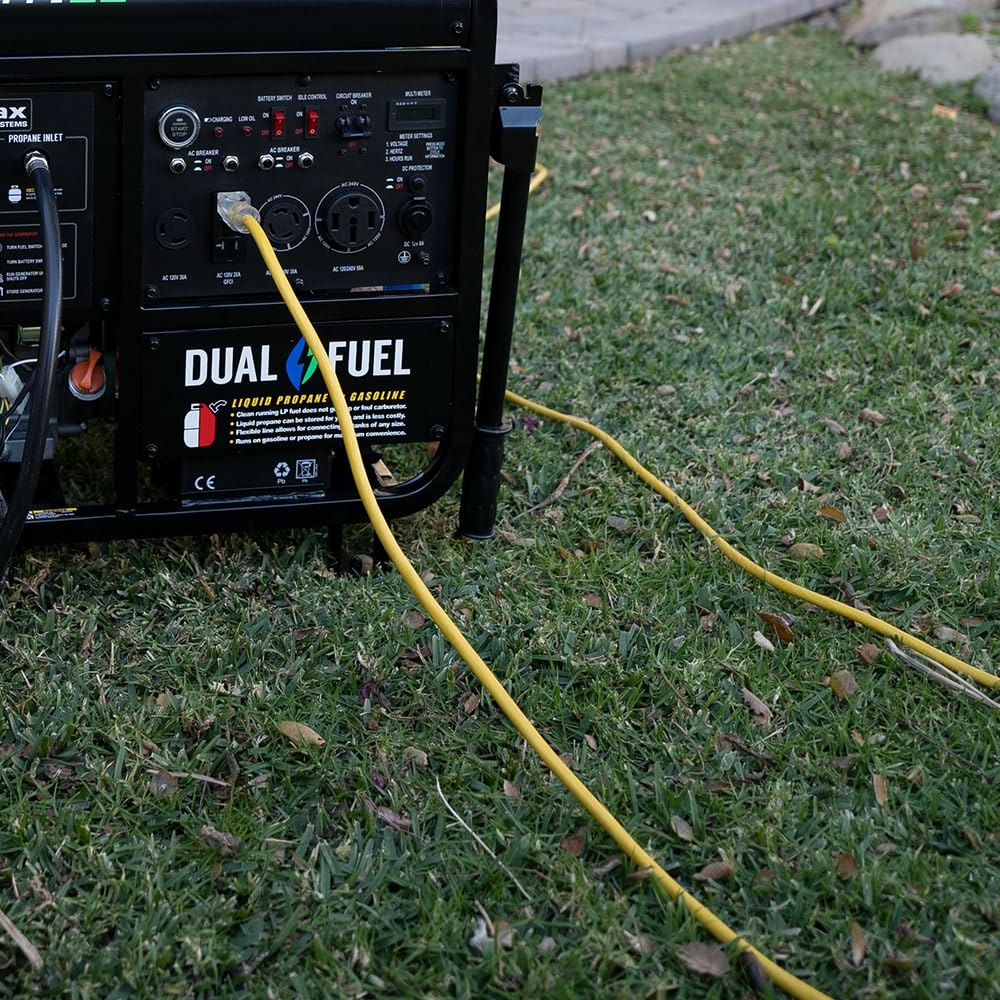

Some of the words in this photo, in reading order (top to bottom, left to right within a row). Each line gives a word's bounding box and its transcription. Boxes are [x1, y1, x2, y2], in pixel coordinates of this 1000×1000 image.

[8, 134, 41, 143] PROPANE
[43, 133, 63, 142] INLET
[184, 344, 278, 387] DUAL
[328, 339, 411, 377] FUEL
[231, 396, 272, 408] LIQUID
[276, 393, 328, 406] PROPANE
[350, 390, 406, 401] GASOLINE
[262, 436, 288, 444] gasoline
[297, 434, 323, 442] propane
[194, 475, 216, 490] CE
